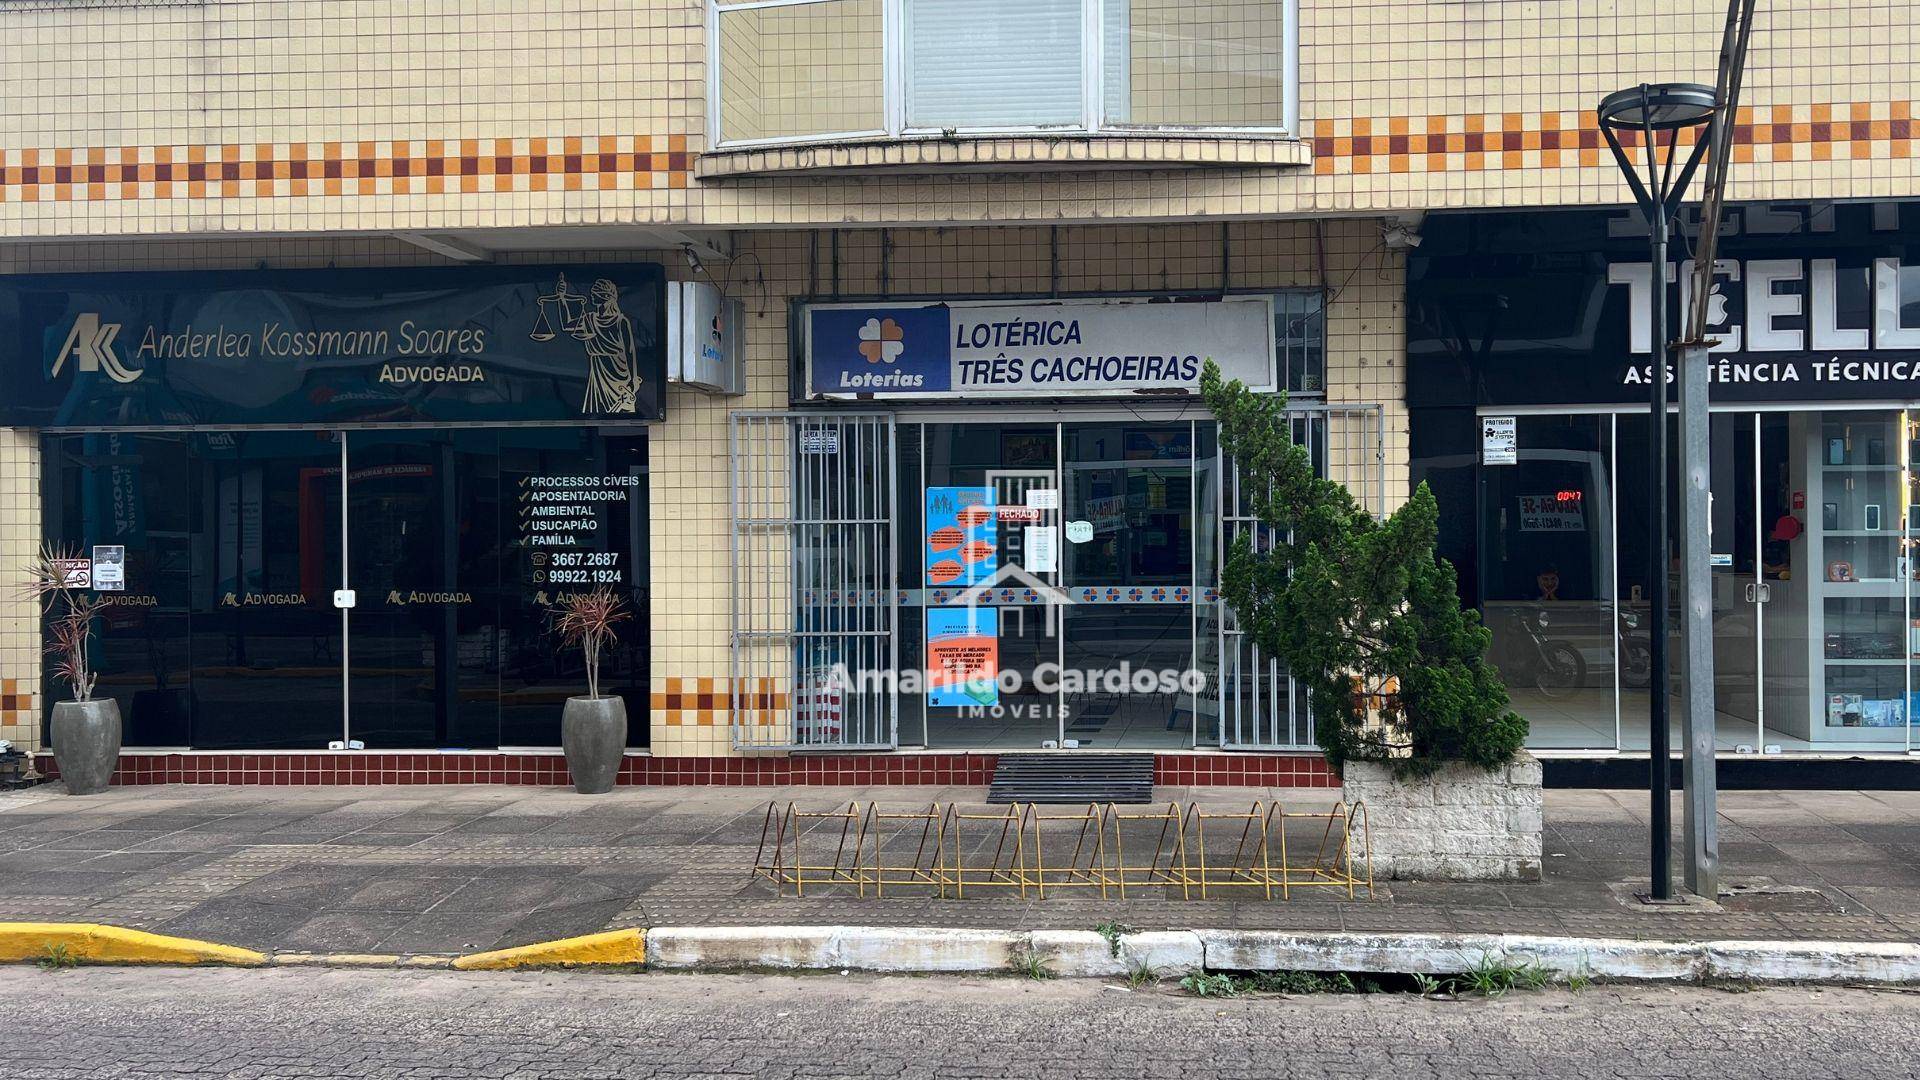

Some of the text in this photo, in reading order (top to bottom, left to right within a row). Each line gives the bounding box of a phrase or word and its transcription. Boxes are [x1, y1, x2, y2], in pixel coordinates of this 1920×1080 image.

[139, 319, 486, 358] Anderlea Kossmann Soares
[956, 319, 1082, 348] LOTÉRICA
[379, 363, 486, 383] ADVOGADA
[958, 353, 1199, 386] TRÊS CACHOEIRAS
[1812, 356, 1920, 381] TÉCNICA
[840, 369, 924, 389] Loterias
[1168, 444, 1200, 453] milhõs
[530, 474, 640, 487] PROCESSOS CÍVEIS
[530, 491, 627, 501] APOSENTADORIA
[1557, 491, 1581, 501] 0047
[531, 506, 595, 516] AMBIENTAL
[999, 508, 1040, 519] FECHADO
[531, 518, 598, 530] USUCAPIÃO
[531, 533, 576, 545] FAMÍLIA
[551, 553, 619, 566] 3667.2687
[549, 570, 622, 583] 99922.1924
[96, 593, 158, 606] ADVOGADA
[244, 592, 307, 605] ADVOGADA
[408, 590, 472, 603] ADVOGADA
